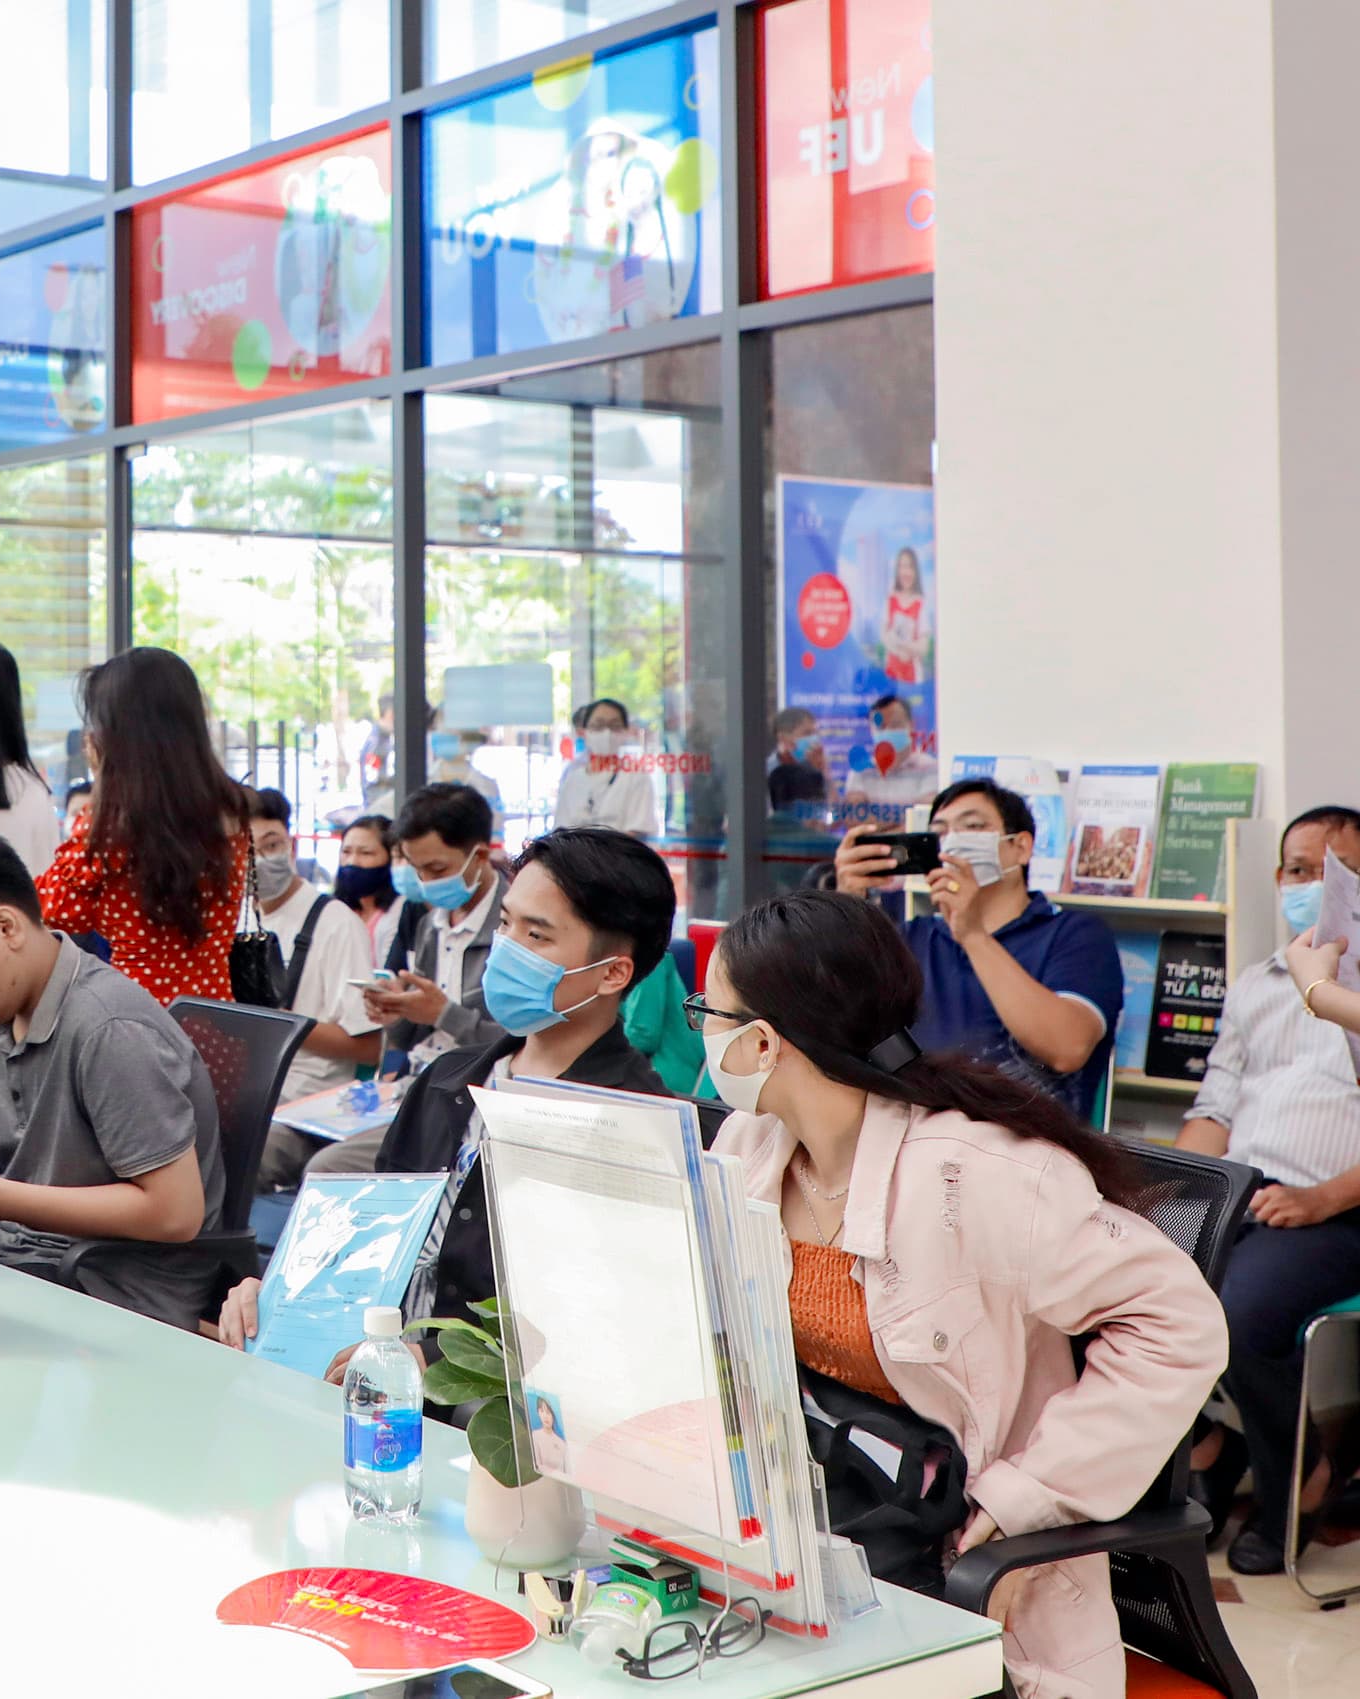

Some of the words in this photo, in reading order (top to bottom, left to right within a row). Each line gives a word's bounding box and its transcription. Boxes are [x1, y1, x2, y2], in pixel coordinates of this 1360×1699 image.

[1170, 796, 1247, 815] Management
[1185, 981, 1200, 997] A
[287, 1591, 366, 1615] YOU
